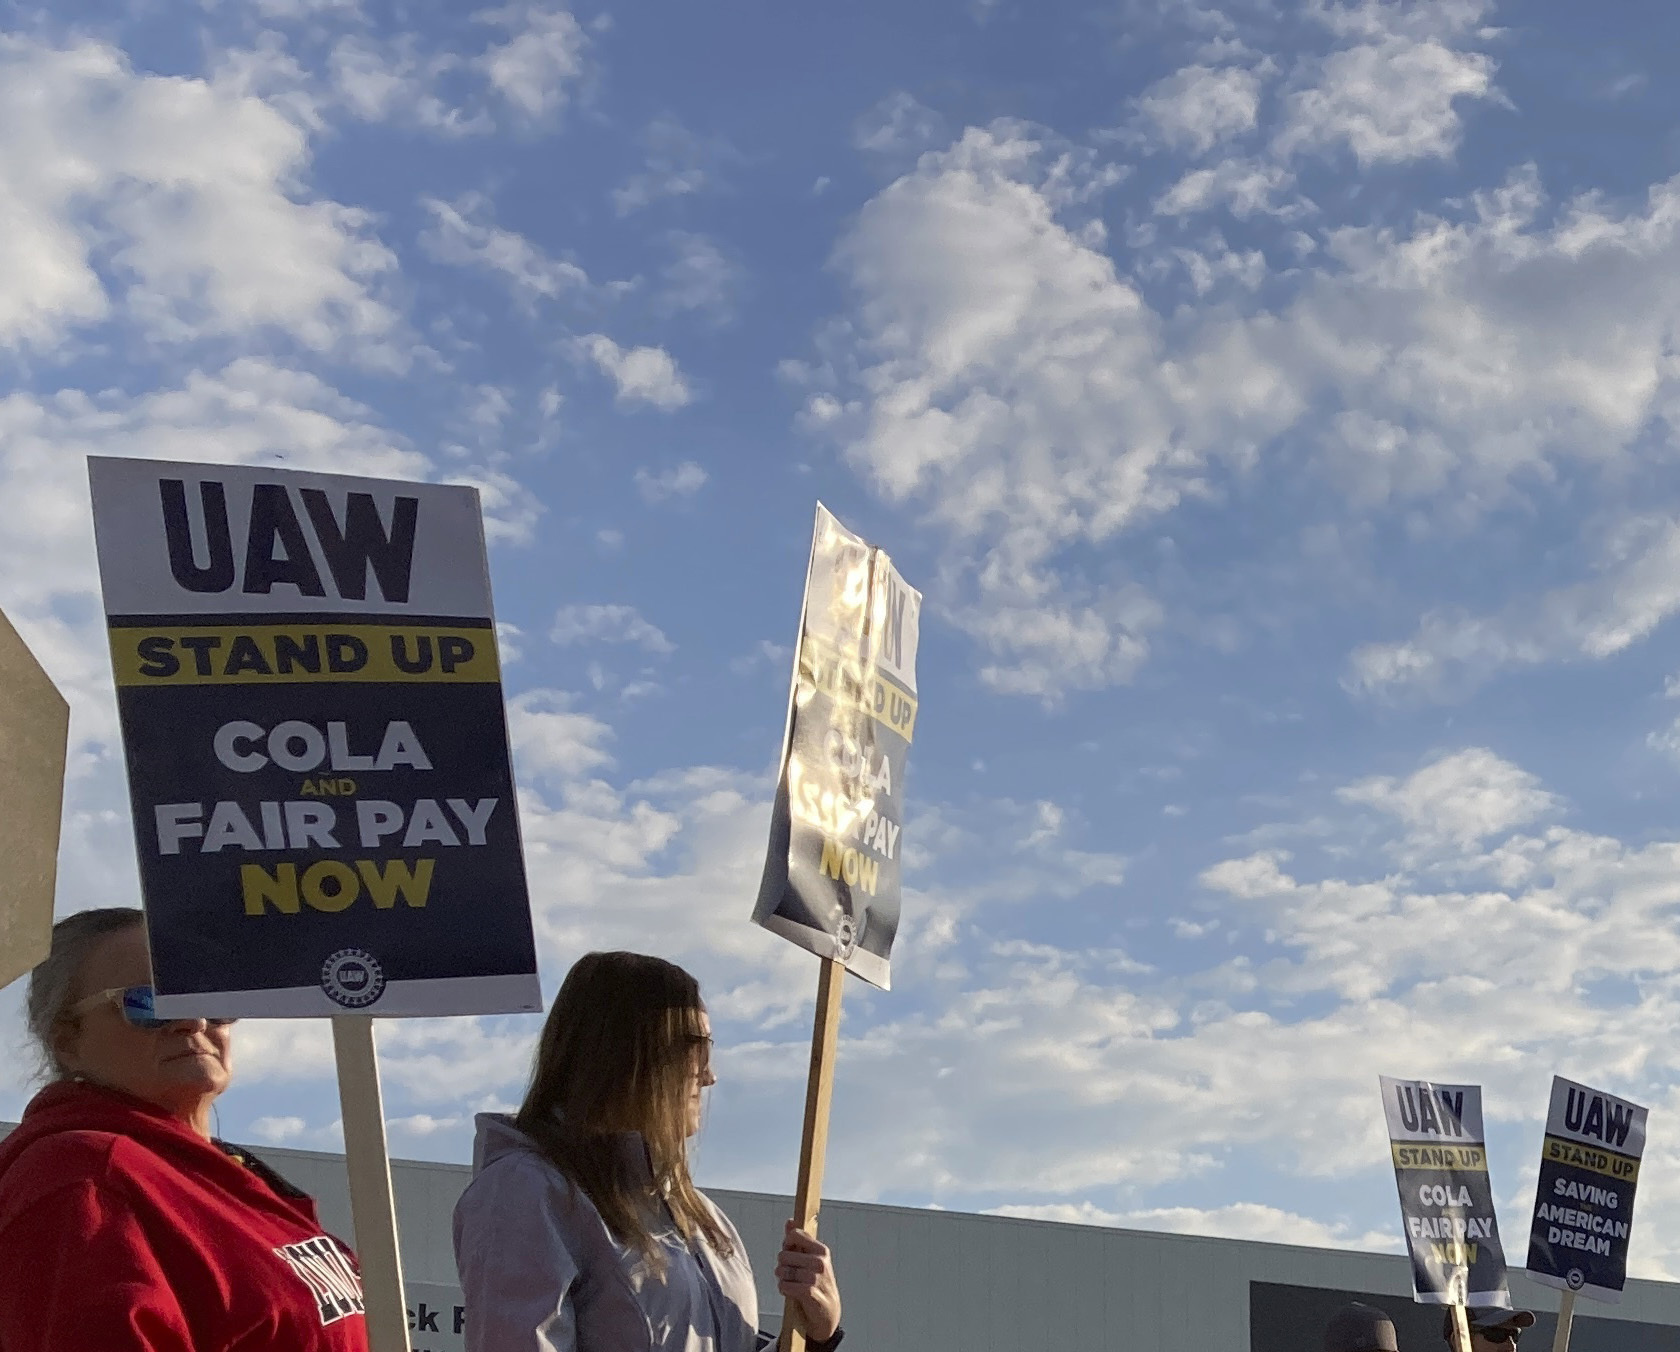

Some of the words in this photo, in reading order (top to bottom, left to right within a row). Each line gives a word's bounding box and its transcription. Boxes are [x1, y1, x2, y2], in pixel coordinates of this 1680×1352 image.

[158, 478, 419, 603] UAW
[137, 634, 368, 677] STAND
[390, 634, 476, 674] UP
[890, 692, 912, 730] UP
[213, 720, 433, 773] COLA
[300, 777, 357, 796] AND
[154, 800, 342, 855] FAIR
[356, 797, 499, 848] PAY
[863, 810, 900, 860] PAY
[819, 836, 879, 896] NOW
[240, 858, 436, 915] NOW
[1395, 1084, 1463, 1137] UAW
[1564, 1087, 1634, 1148] UAW
[1400, 1147, 1455, 1168] STAND
[1460, 1149, 1481, 1166] UP
[1549, 1142, 1608, 1171] STAND
[1612, 1158, 1634, 1177] UP
[1419, 1184, 1473, 1207] COLA
[1554, 1178, 1618, 1209] SAVING
[1408, 1216, 1453, 1238] FAIR
[1453, 1217, 1493, 1240] PAY
[1537, 1202, 1628, 1239] AMERICAN
[1431, 1243, 1477, 1265] NOW
[1548, 1226, 1611, 1256] DREAM
